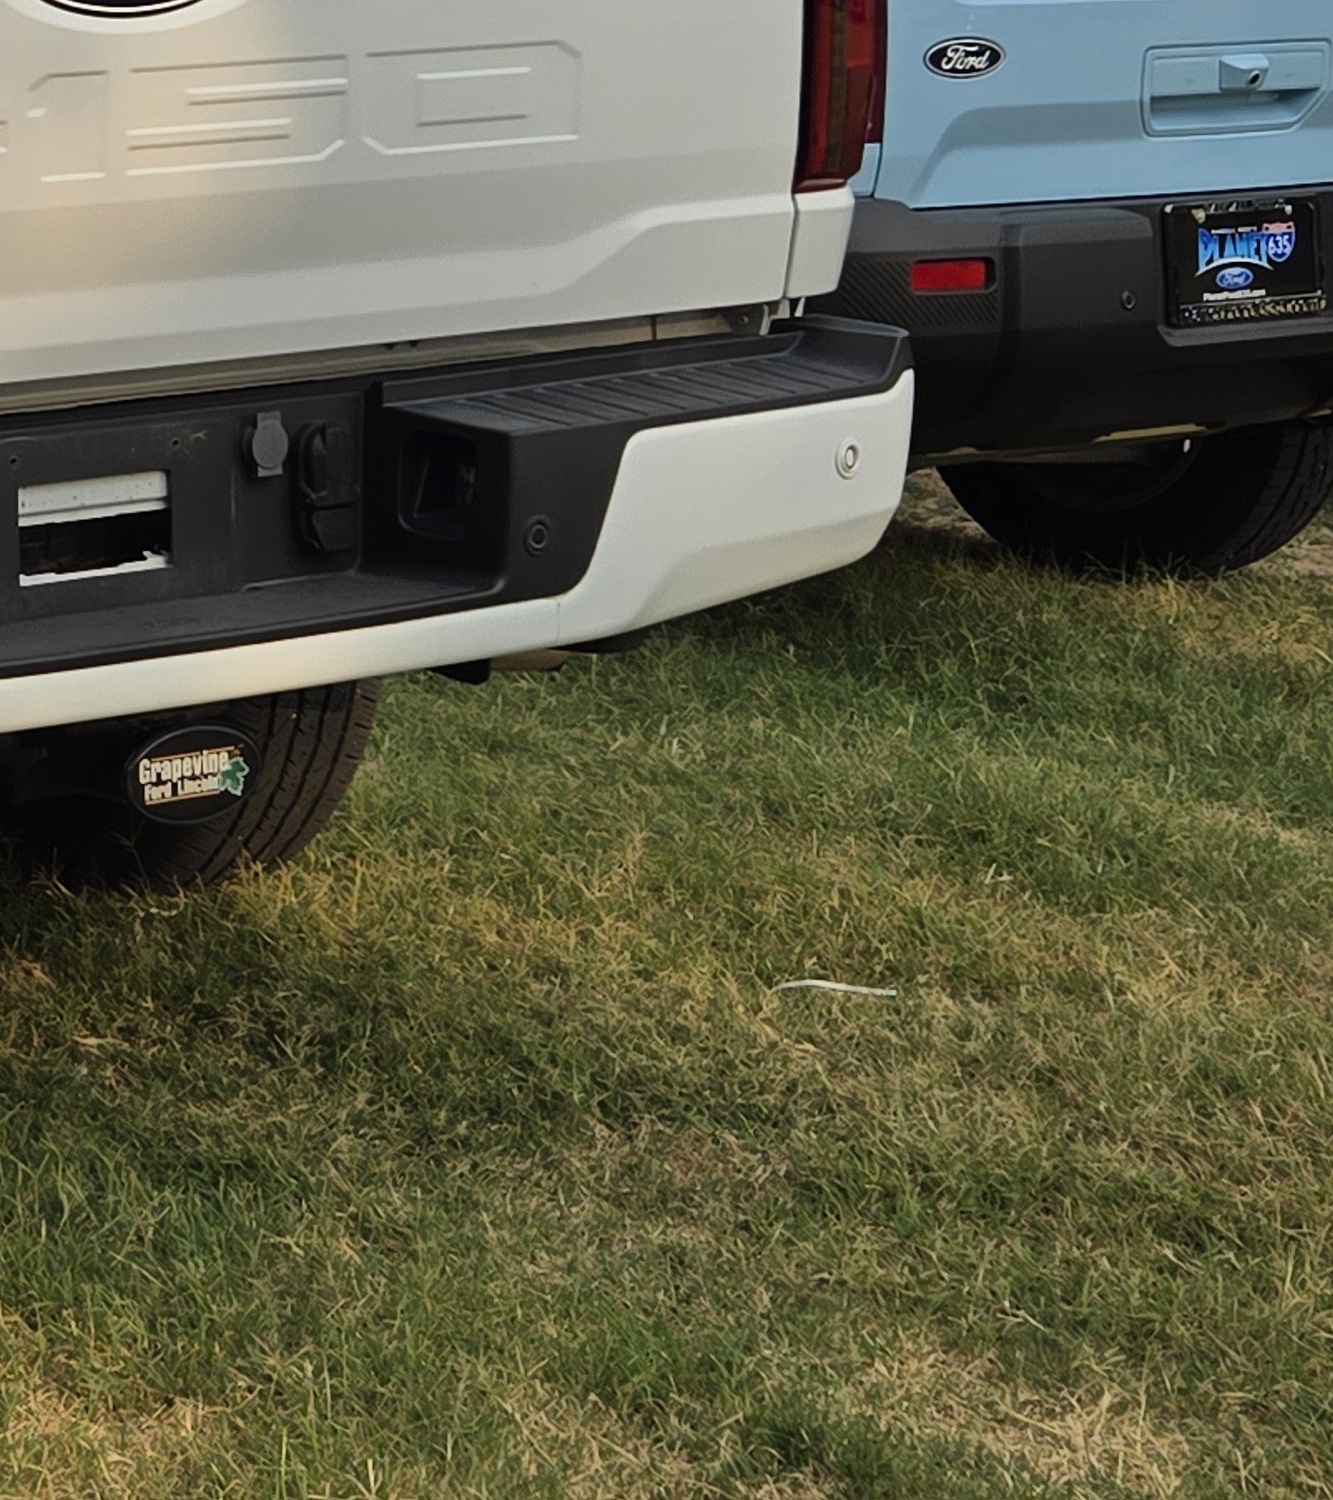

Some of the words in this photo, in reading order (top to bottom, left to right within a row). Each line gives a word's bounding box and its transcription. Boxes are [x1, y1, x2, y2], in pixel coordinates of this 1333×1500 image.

[940, 44, 992, 70] Ford
[1198, 228, 1267, 275] PLANET
[1267, 235, 1290, 255] 635
[138, 750, 229, 784] Grapevine
[144, 781, 172, 801] Ford
